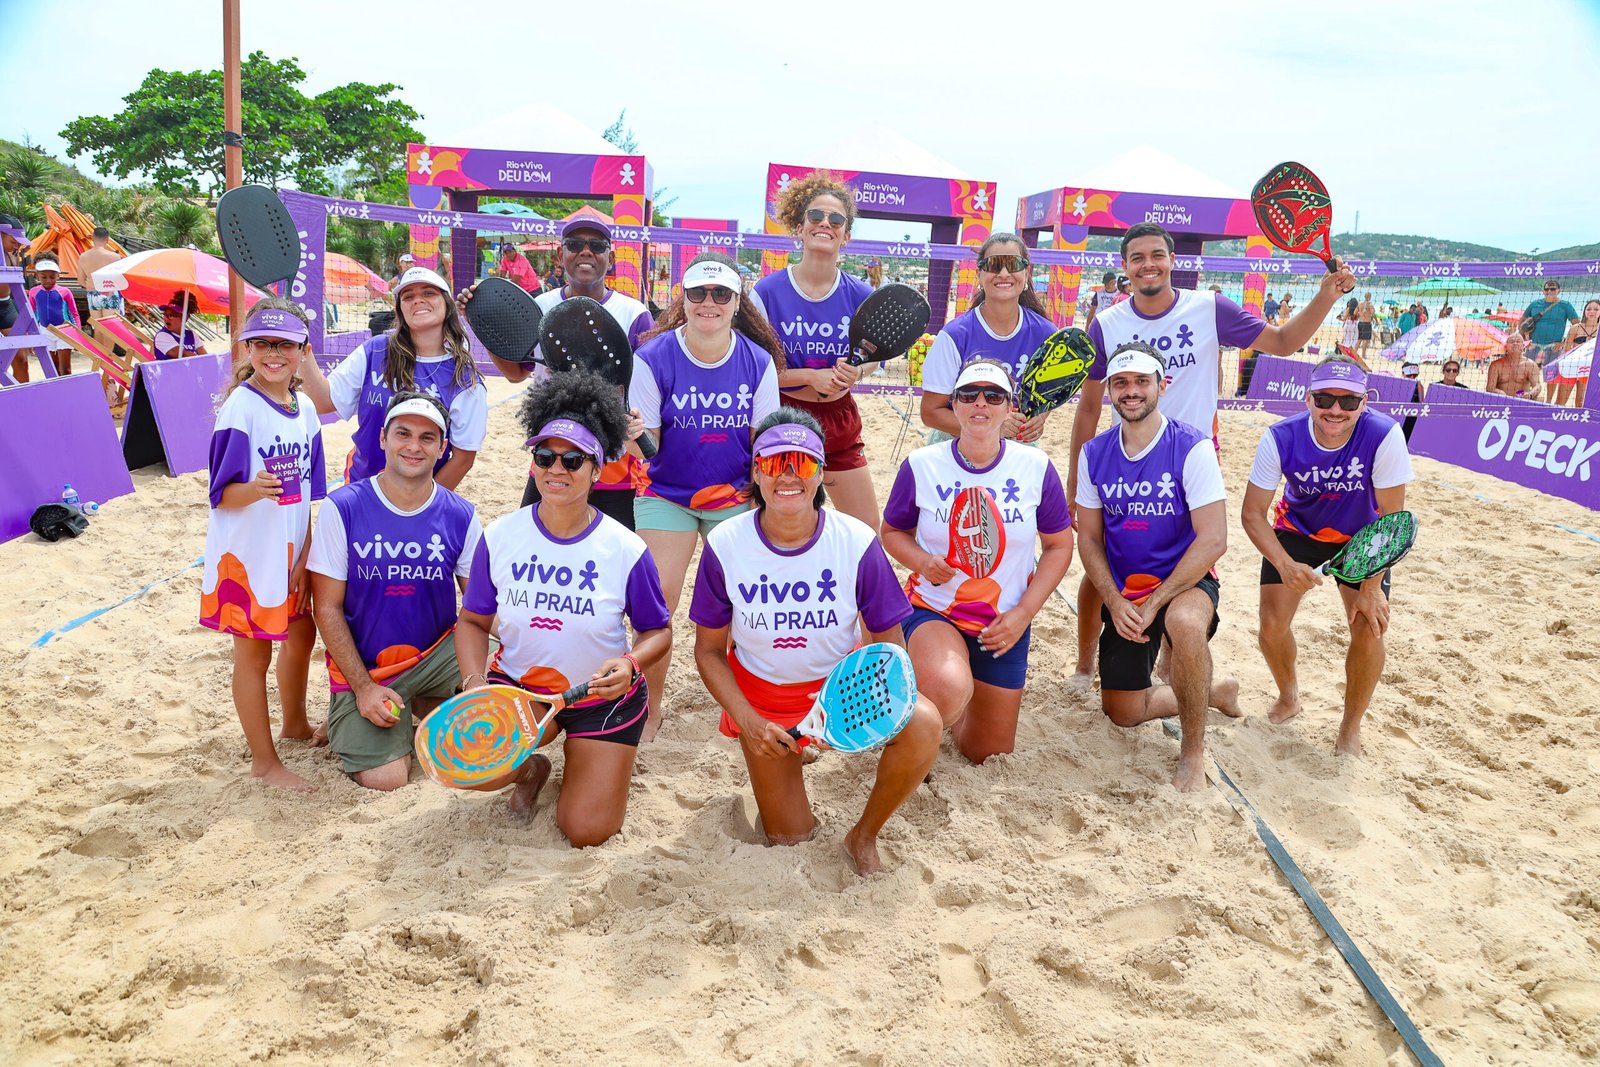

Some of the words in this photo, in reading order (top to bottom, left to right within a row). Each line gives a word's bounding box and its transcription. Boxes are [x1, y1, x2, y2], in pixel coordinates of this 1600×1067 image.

[506, 161, 543, 170] Rio+Vivo
[499, 169, 521, 182] DEU
[524, 170, 551, 183] BOM
[1259, 165, 1290, 196] ULTRA
[863, 183, 898, 192] Rio+Vivo
[855, 191, 877, 203] DEU
[879, 193, 905, 205] BOM
[325, 202, 357, 216] vivo
[1153, 203, 1185, 213] Rio+Vivo
[417, 211, 450, 225] vivo
[1145, 212, 1165, 224] DEU
[1167, 213, 1191, 225] BOM
[512, 219, 544, 233] vivo
[1293, 213, 1328, 247] SHARK
[700, 232, 732, 246] vivo
[887, 243, 919, 256] vivo
[1071, 253, 1102, 266] vivo
[1174, 260, 1192, 268] vo
[1250, 259, 1279, 271] vivo
[1420, 263, 1449, 276] vivo
[1504, 264, 1533, 276] vivo
[1587, 262, 1600, 274] vi
[780, 315, 833, 337] vivo
[782, 341, 803, 354] NA
[870, 387, 902, 395] vivo
[1280, 376, 1305, 400] vivo
[367, 390, 383, 407] NA
[671, 386, 733, 409] vivo
[1223, 401, 1252, 411] vivo
[1390, 405, 1418, 417] vivo
[1472, 407, 1499, 419] vivo
[673, 415, 697, 429] NA
[701, 414, 750, 428] PRAIA
[1552, 409, 1579, 422] vivo
[257, 435, 301, 459] vivo
[271, 462, 293, 470] vivo
[1294, 466, 1343, 483] vivo
[1102, 476, 1153, 499] vivo
[1299, 484, 1322, 495] NA
[935, 507, 950, 523] N
[1103, 502, 1124, 516] NA
[1127, 502, 1175, 516] PRAIA
[352, 533, 422, 559] vivo
[357, 565, 382, 580] NA
[387, 564, 444, 581] PRAIA
[511, 554, 573, 587] vivo
[738, 574, 810, 604] vivo
[505, 588, 529, 608] NA
[534, 591, 596, 616] PRAIA
[741, 611, 768, 630] NA
[774, 609, 839, 630] PRAIA
